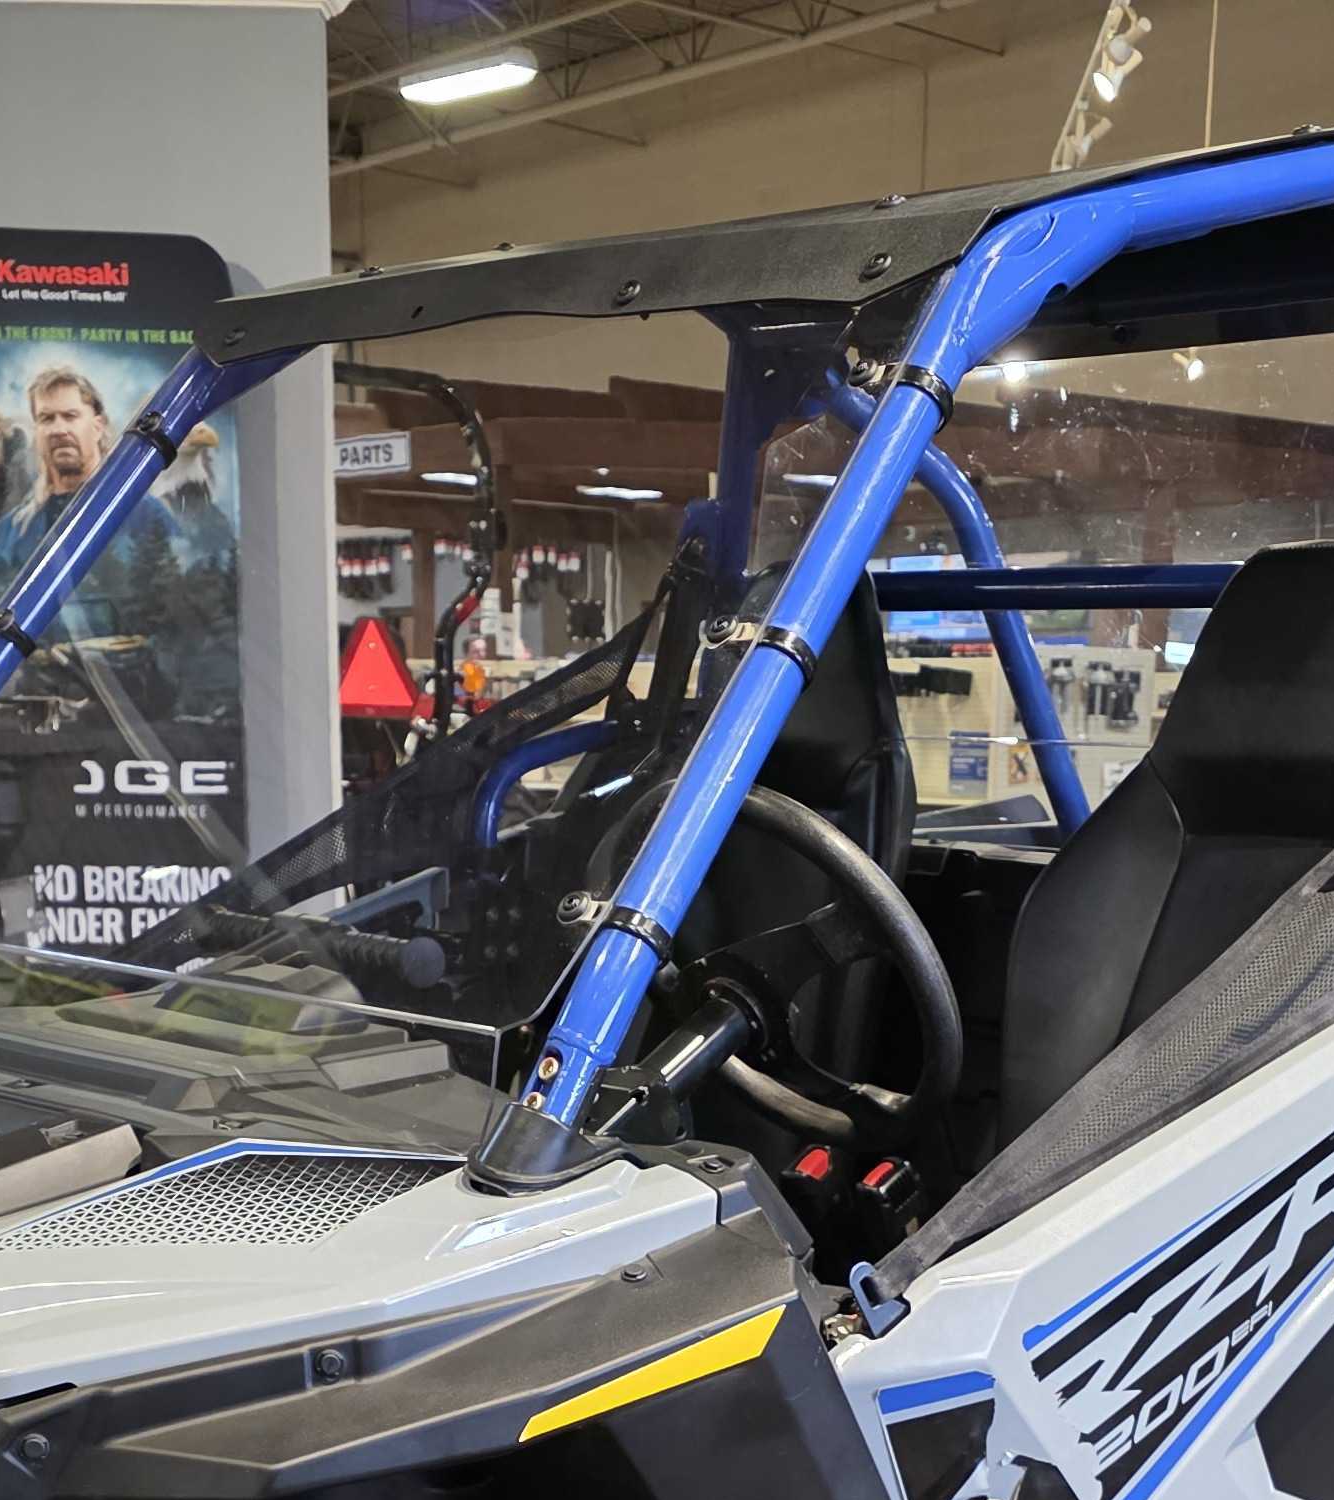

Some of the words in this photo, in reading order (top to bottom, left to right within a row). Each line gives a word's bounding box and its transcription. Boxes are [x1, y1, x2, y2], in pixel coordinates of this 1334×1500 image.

[1, 288, 20, 300] Let
[40, 289, 69, 301] Good
[70, 290, 101, 303] Times
[5, 326, 28, 340] THE
[80, 327, 123, 343] PARTY
[125, 328, 139, 343] IN
[142, 329, 166, 344] THE
[340, 443, 393, 466] PARTS
[93, 803, 208, 819] PERFORMANCE
[33, 864, 77, 902] NO
[1231, 1300, 1273, 1346] EFI
